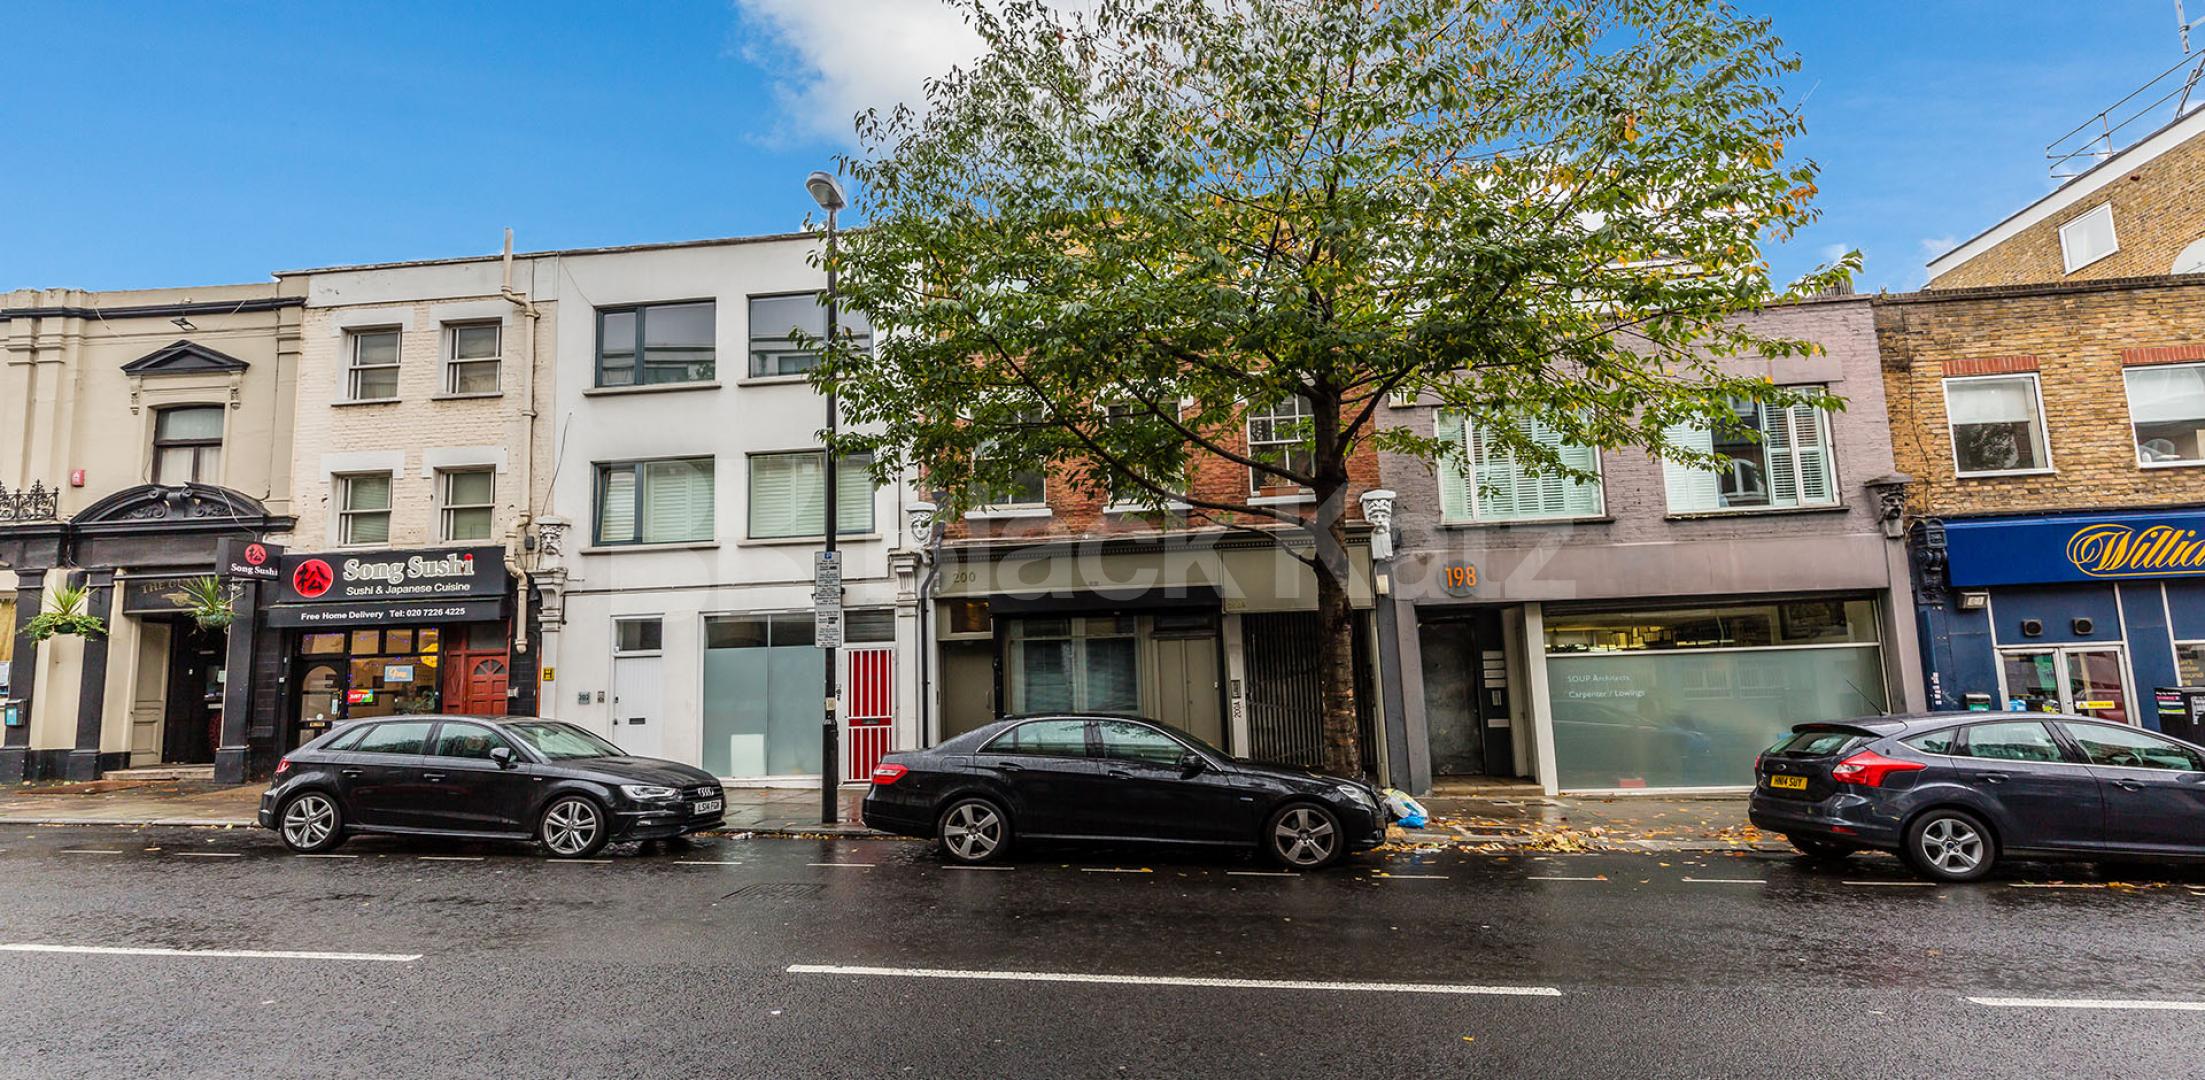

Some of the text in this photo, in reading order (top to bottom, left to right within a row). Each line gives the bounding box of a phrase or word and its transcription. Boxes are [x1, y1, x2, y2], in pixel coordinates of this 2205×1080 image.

[231, 563, 278, 576] Song Sushi
[342, 553, 475, 584] Song Sushi
[297, 563, 329, 593] 松
[953, 571, 976, 583] 200
[1445, 566, 1477, 588] 198
[346, 582, 471, 595] Sushi & Japanese Cuisine
[301, 607, 466, 620] Free Home Delivery Tel: 020 7226 4225
